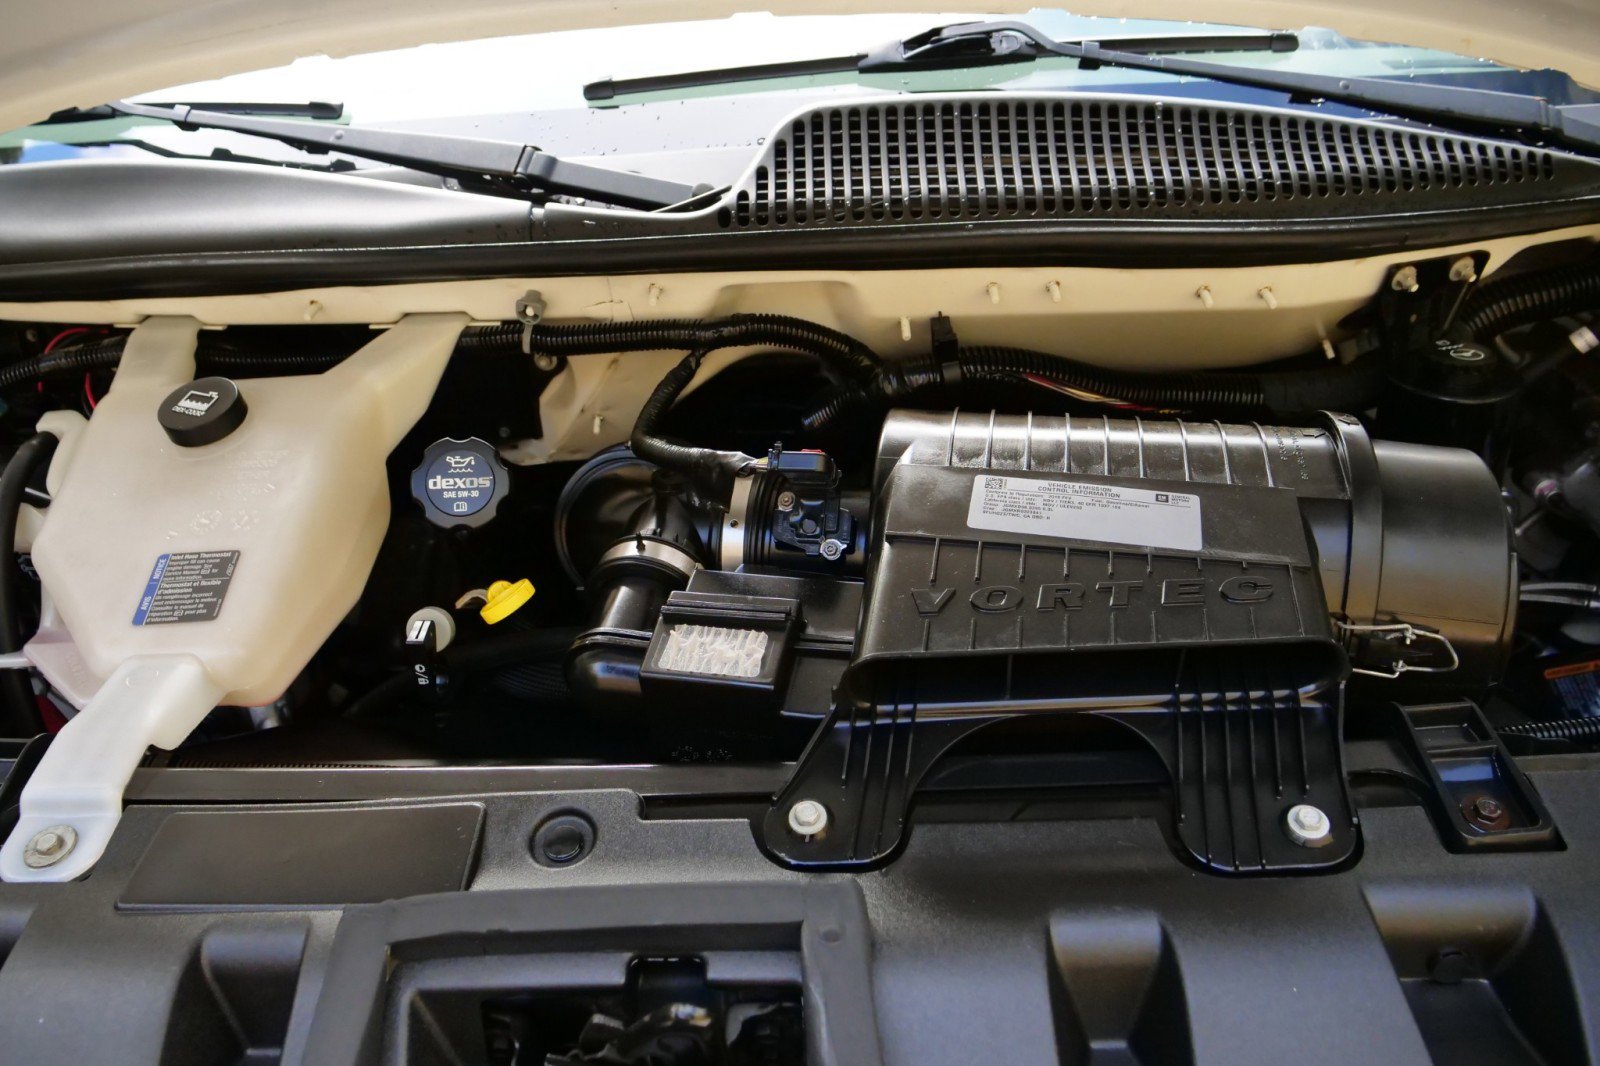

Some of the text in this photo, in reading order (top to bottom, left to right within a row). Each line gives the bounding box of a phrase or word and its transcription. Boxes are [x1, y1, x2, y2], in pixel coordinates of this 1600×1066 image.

[428, 475, 490, 490] dexos
[1072, 489, 1120, 498] INFORMATION
[152, 558, 167, 580] NOTICE
[911, 575, 1274, 616] VORTEC
[140, 596, 152, 611] AVIS
